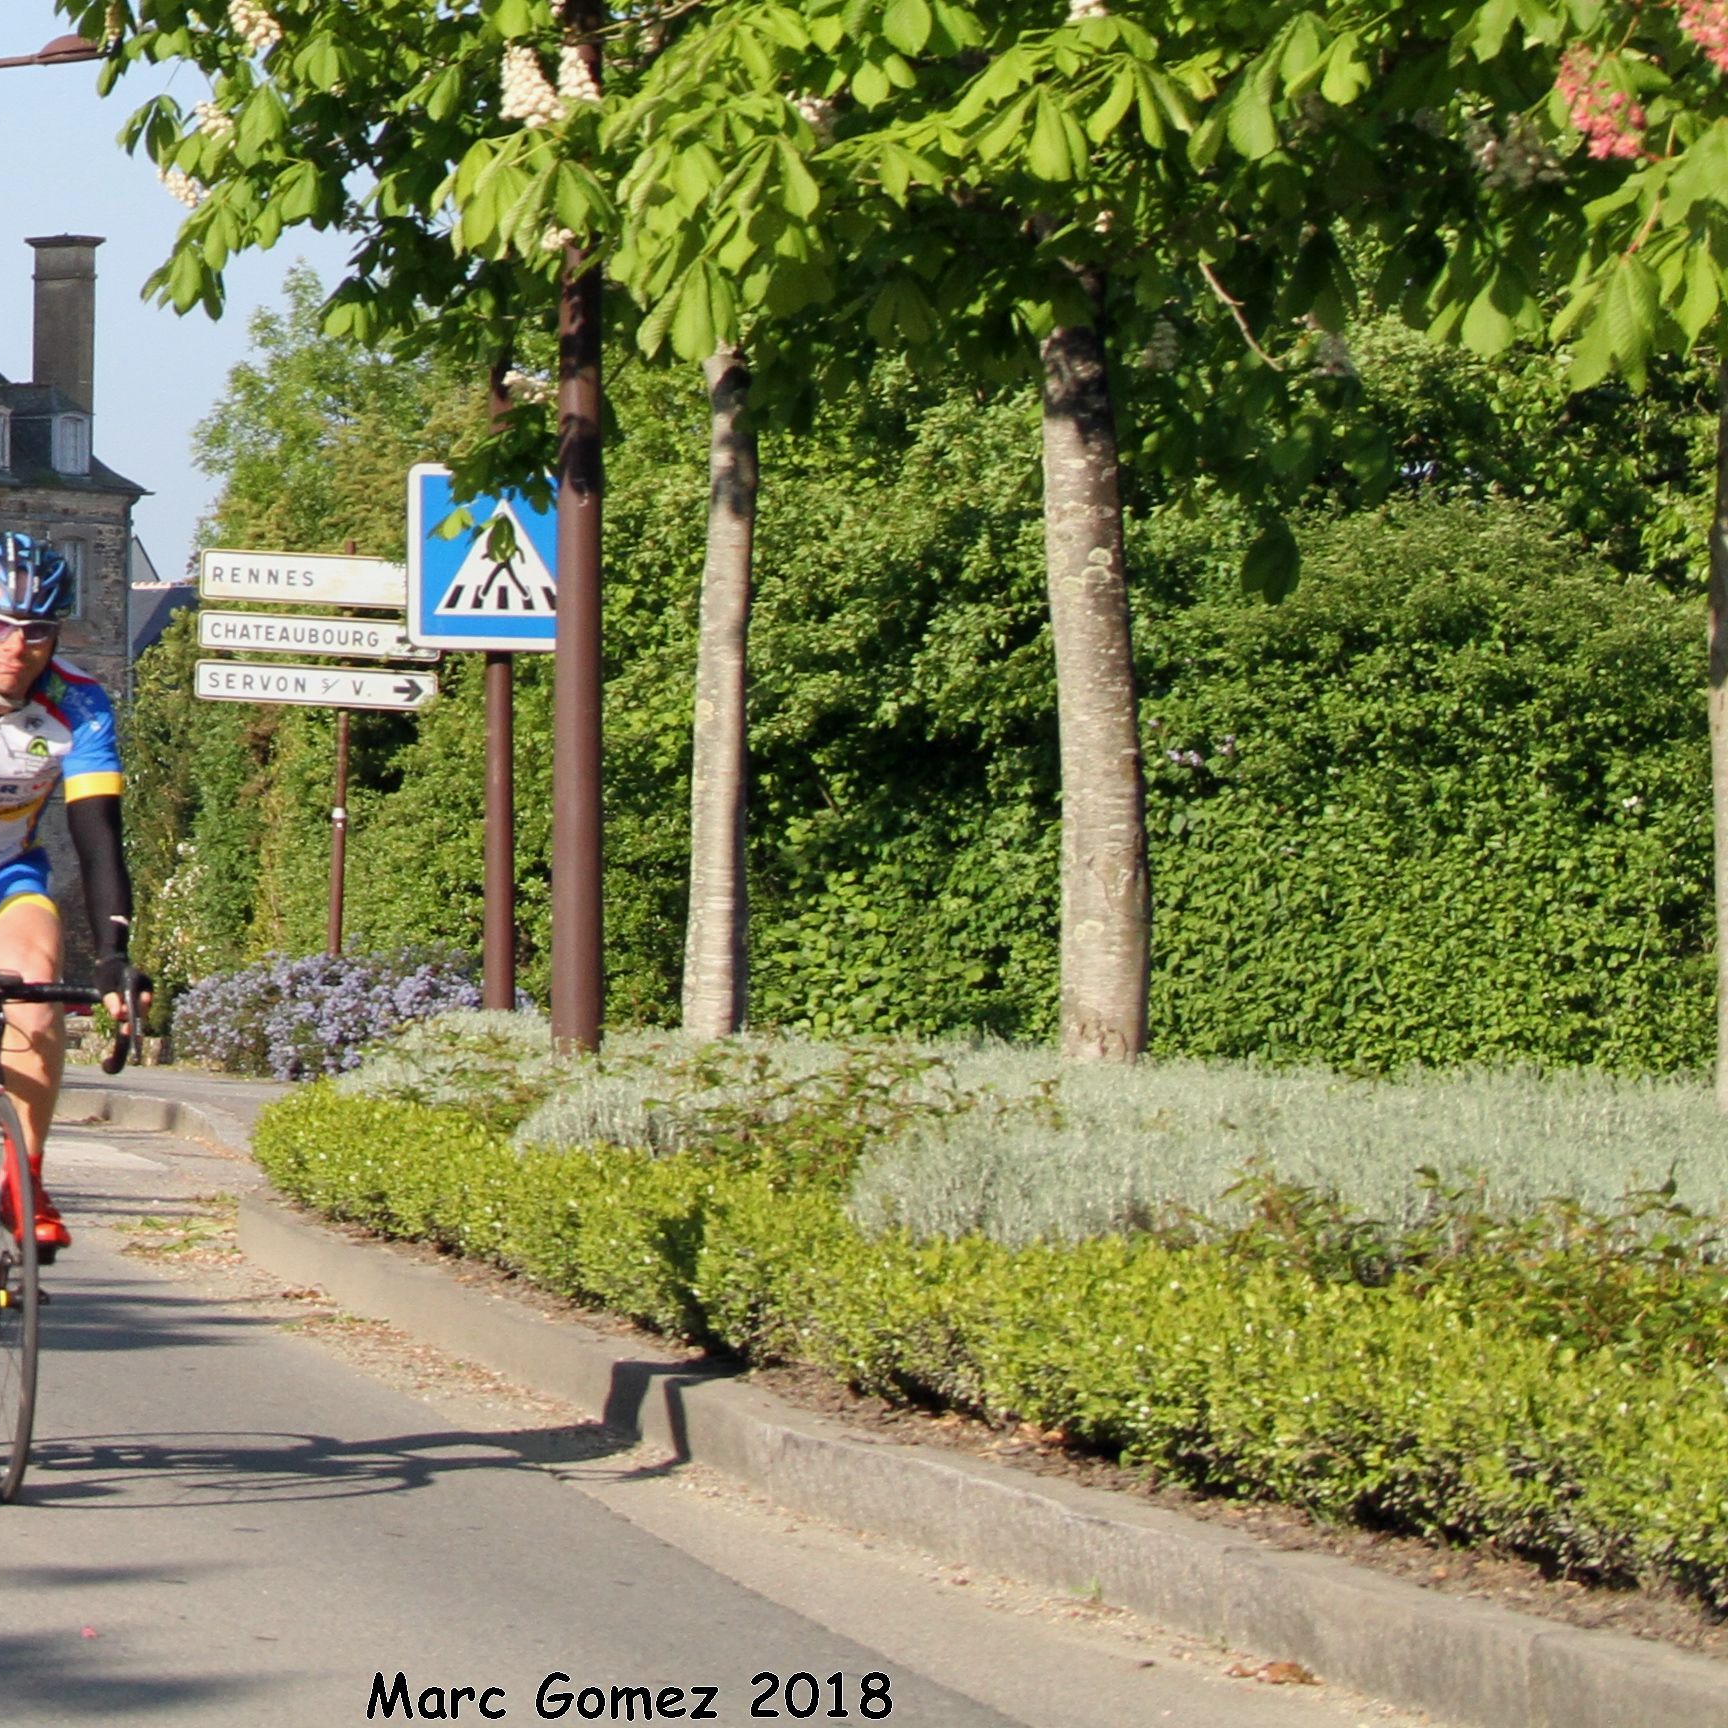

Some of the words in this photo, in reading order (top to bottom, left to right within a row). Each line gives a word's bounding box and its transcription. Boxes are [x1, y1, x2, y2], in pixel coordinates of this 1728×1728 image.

[212, 566, 315, 587] RENNES
[211, 622, 380, 648] CHATEAUBOURG
[208, 672, 307, 694] SERVON
